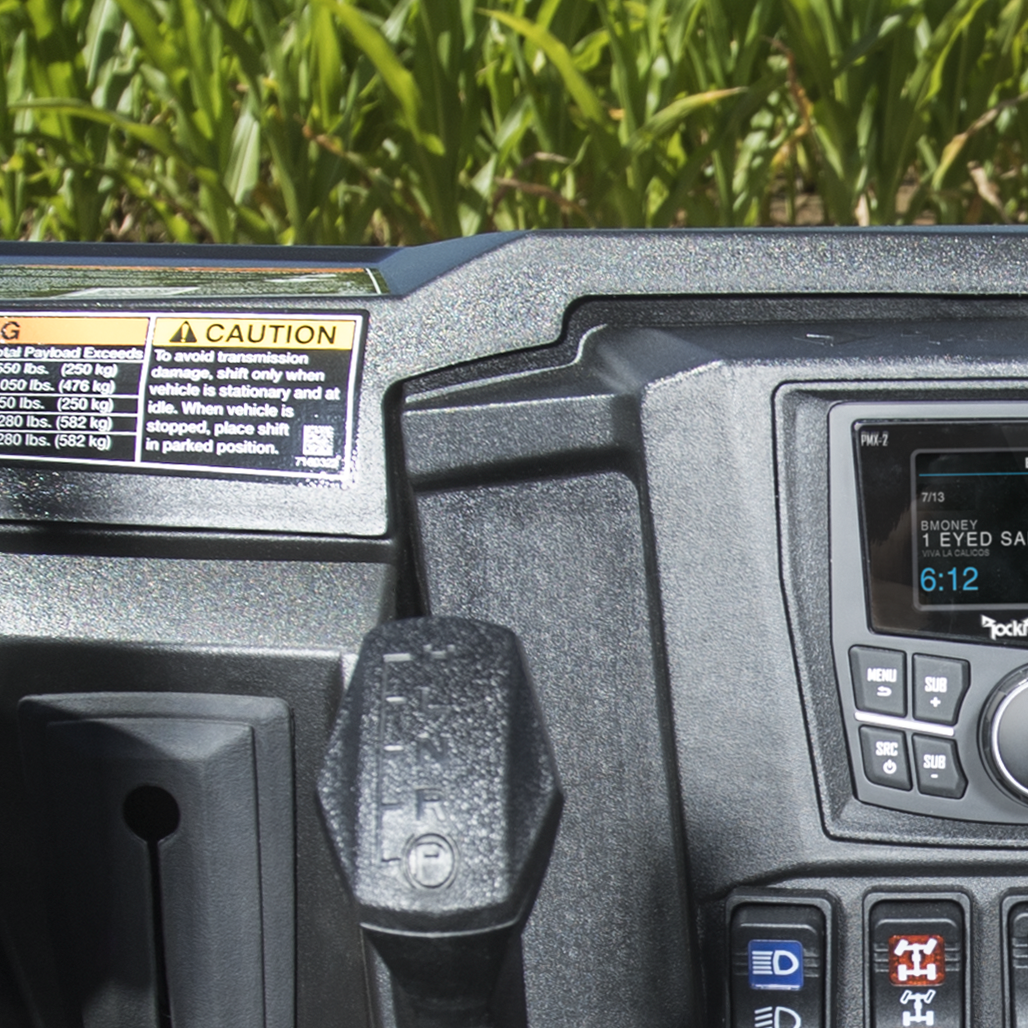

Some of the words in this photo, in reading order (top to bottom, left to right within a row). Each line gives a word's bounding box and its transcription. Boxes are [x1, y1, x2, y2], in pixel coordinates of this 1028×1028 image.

[205, 323, 337, 345] CAUTION
[24, 346, 81, 360] Payload
[83, 347, 144, 359] Exceeds
[154, 349, 171, 362] To
[174, 350, 215, 363] avoid
[217, 351, 309, 365] transmission
[23, 363, 49, 375] lbs.
[61, 363, 92, 378] (250
[95, 364, 118, 378] kg)
[151, 366, 214, 381] damage,
[217, 367, 249, 380] shift
[251, 368, 283, 383] only
[285, 369, 325, 382] when
[29, 379, 55, 391] lbs.
[58, 379, 90, 394] (476
[92, 380, 116, 395] kg)
[149, 383, 200, 396] vehicle
[203, 384, 216, 397] is
[219, 384, 291, 402] stationary
[293, 387, 322, 400] and
[325, 387, 340, 400] at
[19, 397, 45, 409] lbs.
[57, 397, 88, 411] (250
[90, 398, 114, 413] kg)
[147, 400, 178, 414] idle.
[181, 401, 224, 416] When
[226, 402, 278, 417] vehicle
[281, 404, 295, 418] is
[26, 415, 52, 428] lbs.
[56, 416, 86, 431] (582
[89, 416, 113, 432] kg)
[146, 420, 210, 436] stopped,
[214, 421, 255, 436] place
[257, 422, 290, 437] shift
[25, 434, 51, 446] lbs.
[54, 434, 86, 449] (582
[88, 435, 112, 450] kg)
[145, 437, 159, 451] in
[162, 438, 213, 454] parked
[216, 440, 280, 455] position.
[860, 432, 889, 447] PMX-2
[920, 491, 945, 503] 7/13
[920, 519, 978, 531] BMONEY
[922, 532, 930, 547] 1
[940, 531, 993, 547] EYED
[920, 566, 979, 592] 6:12
[867, 668, 897, 683] MENU
[924, 676, 948, 693] SUB
[875, 741, 899, 757] SRC
[923, 754, 946, 770] SUB
